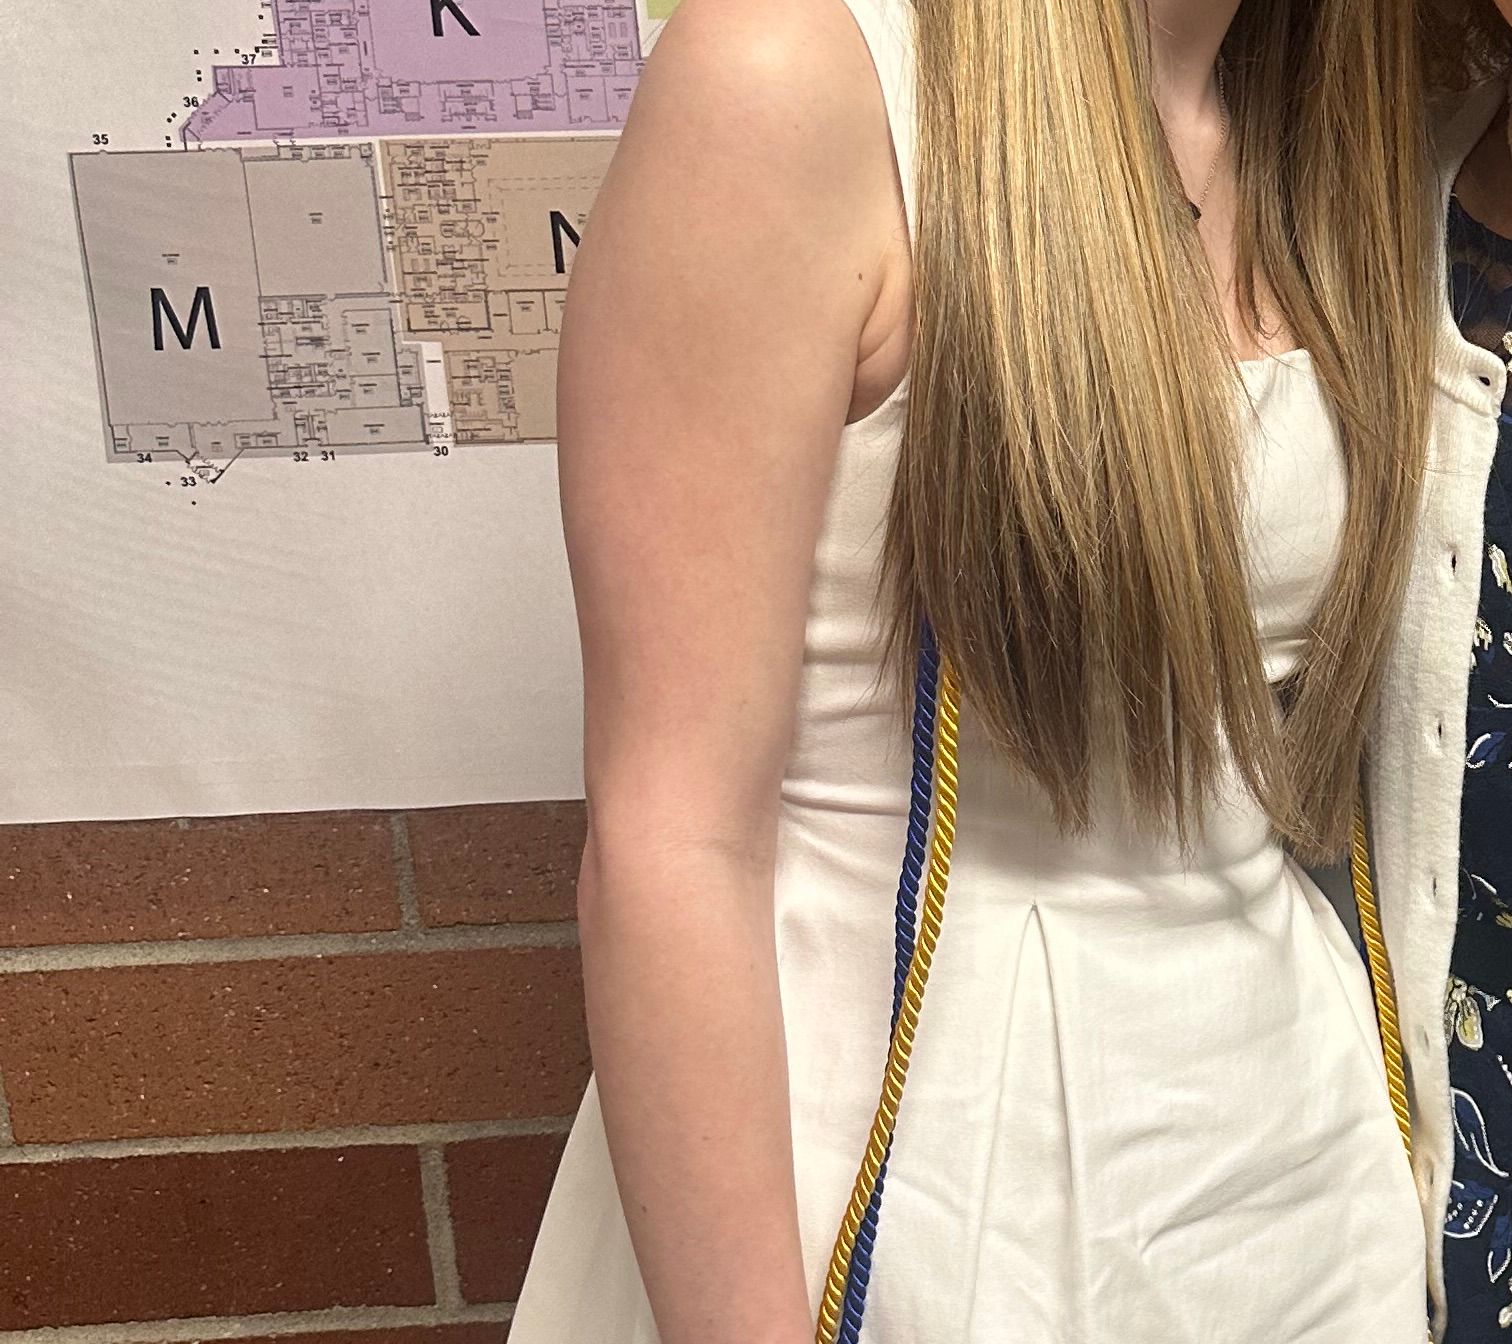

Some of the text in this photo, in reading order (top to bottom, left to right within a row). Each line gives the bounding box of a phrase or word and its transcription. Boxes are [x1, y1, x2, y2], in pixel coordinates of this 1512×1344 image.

[241, 53, 257, 65] 37
[182, 96, 199, 108] 36
[92, 133, 109, 146] 35
[151, 287, 221, 351] M
[292, 451, 309, 463] 32
[321, 450, 336, 462] 31
[433, 445, 449, 457] 30
[136, 452, 153, 464] 34
[180, 476, 198, 488] 33
